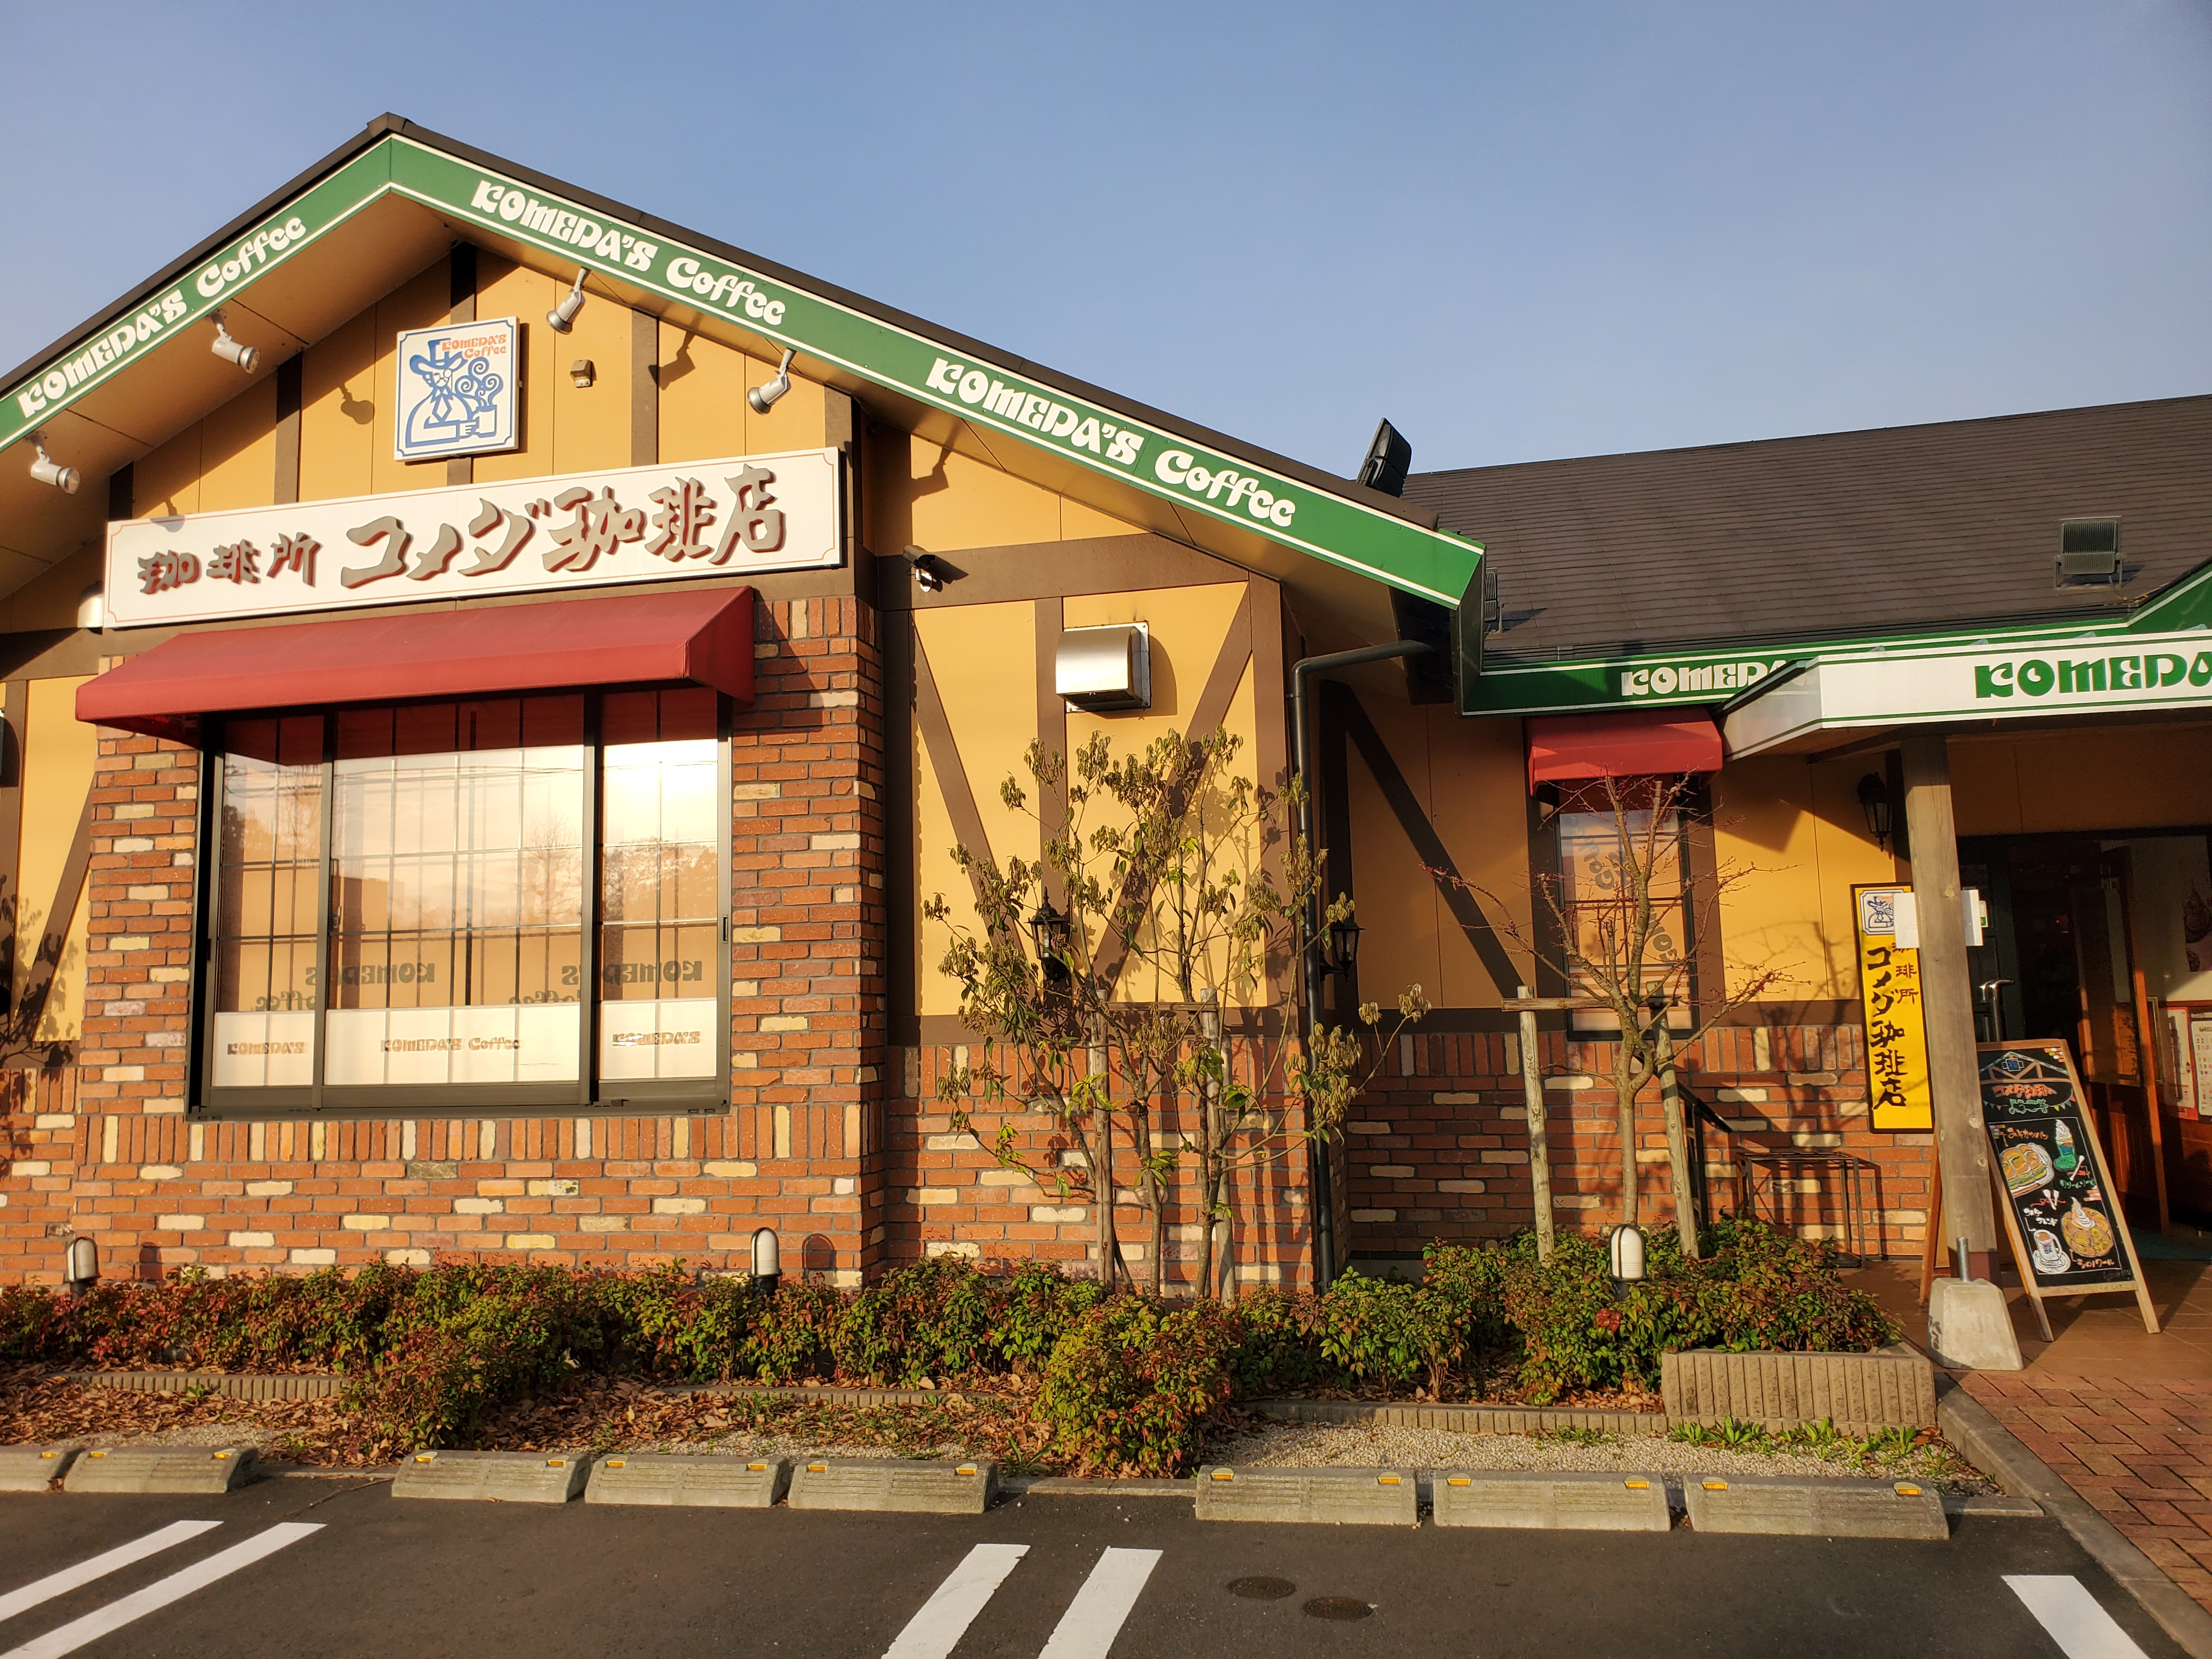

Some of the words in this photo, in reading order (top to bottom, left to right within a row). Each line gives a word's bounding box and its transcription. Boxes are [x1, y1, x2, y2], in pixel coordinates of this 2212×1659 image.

[470, 180, 658, 272] KOMEDA'S
[665, 257, 786, 325] Coffee
[17, 289, 187, 419] KOMEDA'S
[197, 217, 306, 297] Coffee
[442, 334, 507, 351] KOMEDA'S
[464, 346, 507, 359] Coffee
[925, 357, 1145, 465] KOMEDA'S
[1155, 450, 1296, 527] Coffee
[138, 531, 323, 594] 珈琲所
